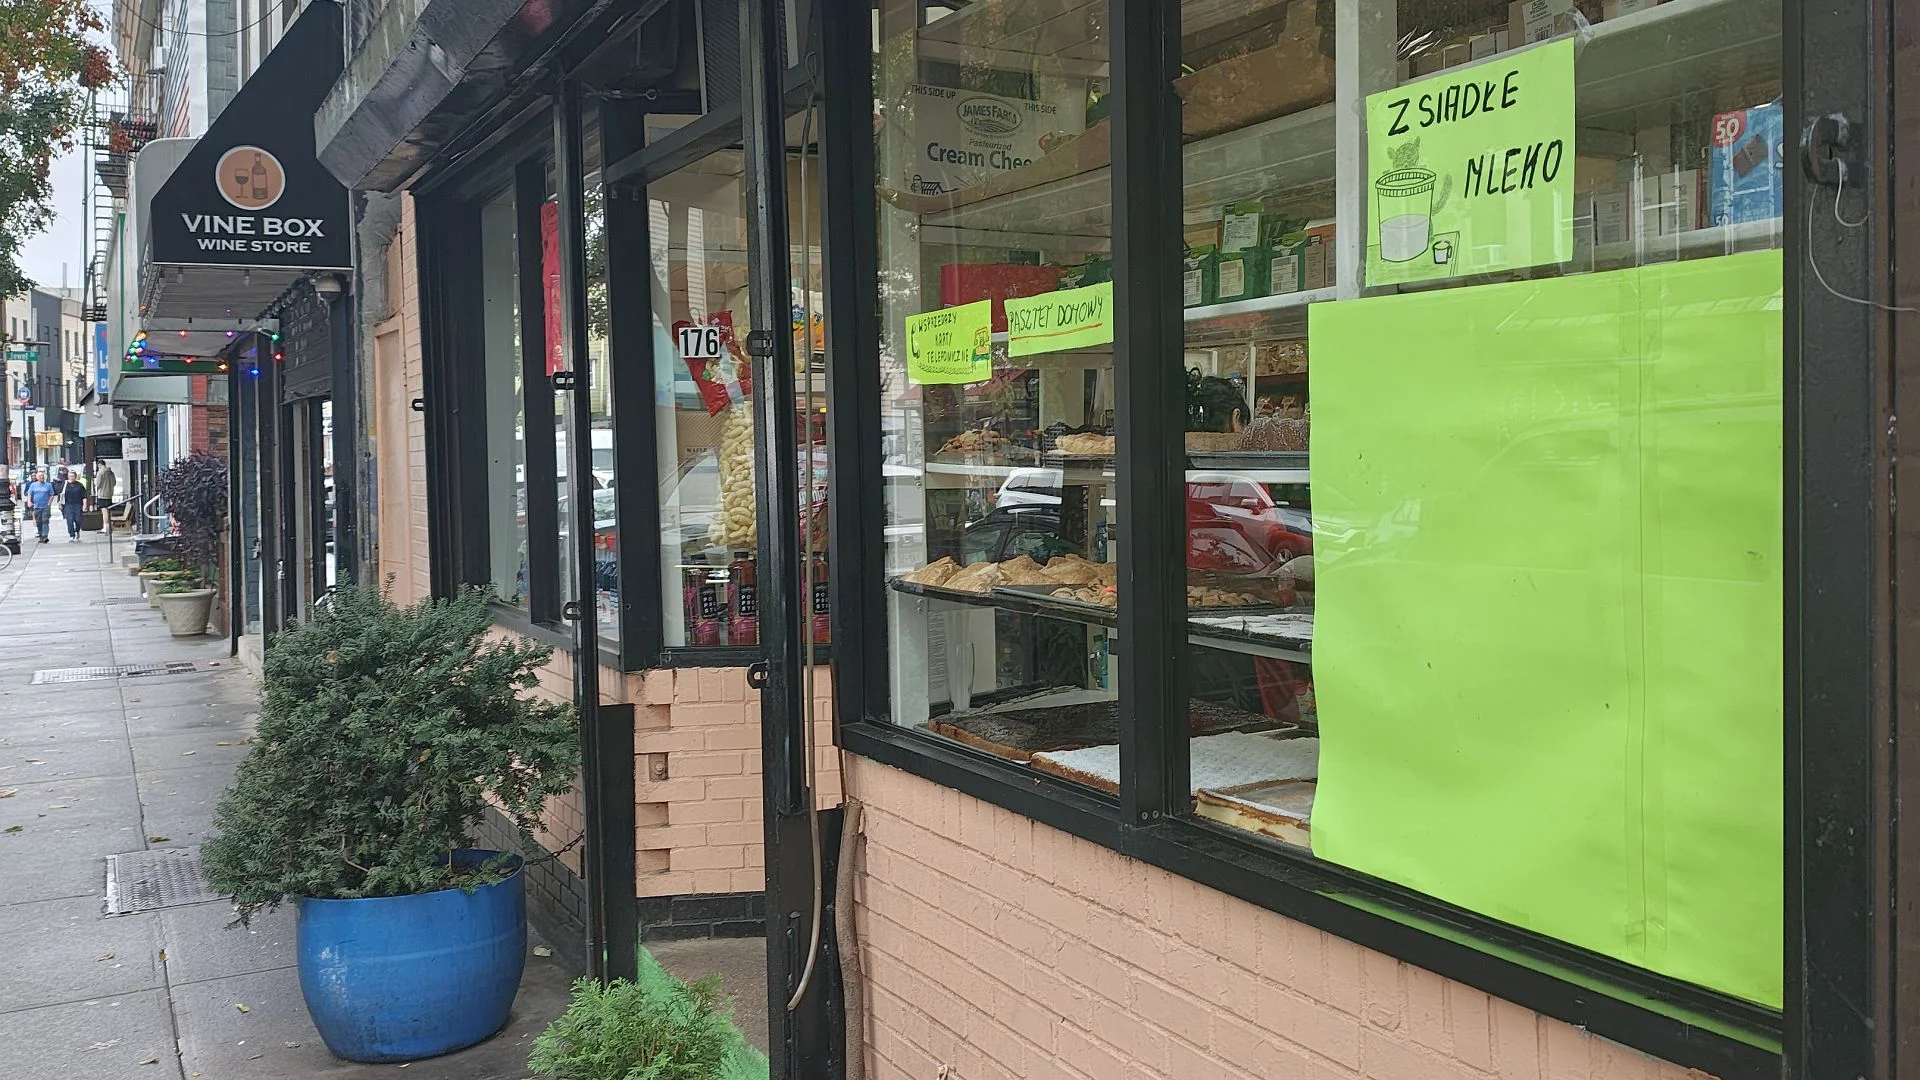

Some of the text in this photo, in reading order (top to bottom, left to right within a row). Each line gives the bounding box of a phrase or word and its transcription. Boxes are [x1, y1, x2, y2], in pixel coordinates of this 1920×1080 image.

[929, 87, 944, 98] SIDE
[946, 89, 956, 100] UP
[963, 104, 991, 117] JAMES
[1023, 102, 1039, 112] THIS
[1716, 117, 1739, 140] 50
[927, 142, 985, 167] Cream
[181, 212, 325, 237] VINE BOX
[197, 238, 311, 254] WINE STORE
[1009, 295, 1103, 335] PASZTET DOMOWY
[680, 329, 718, 356] 176
